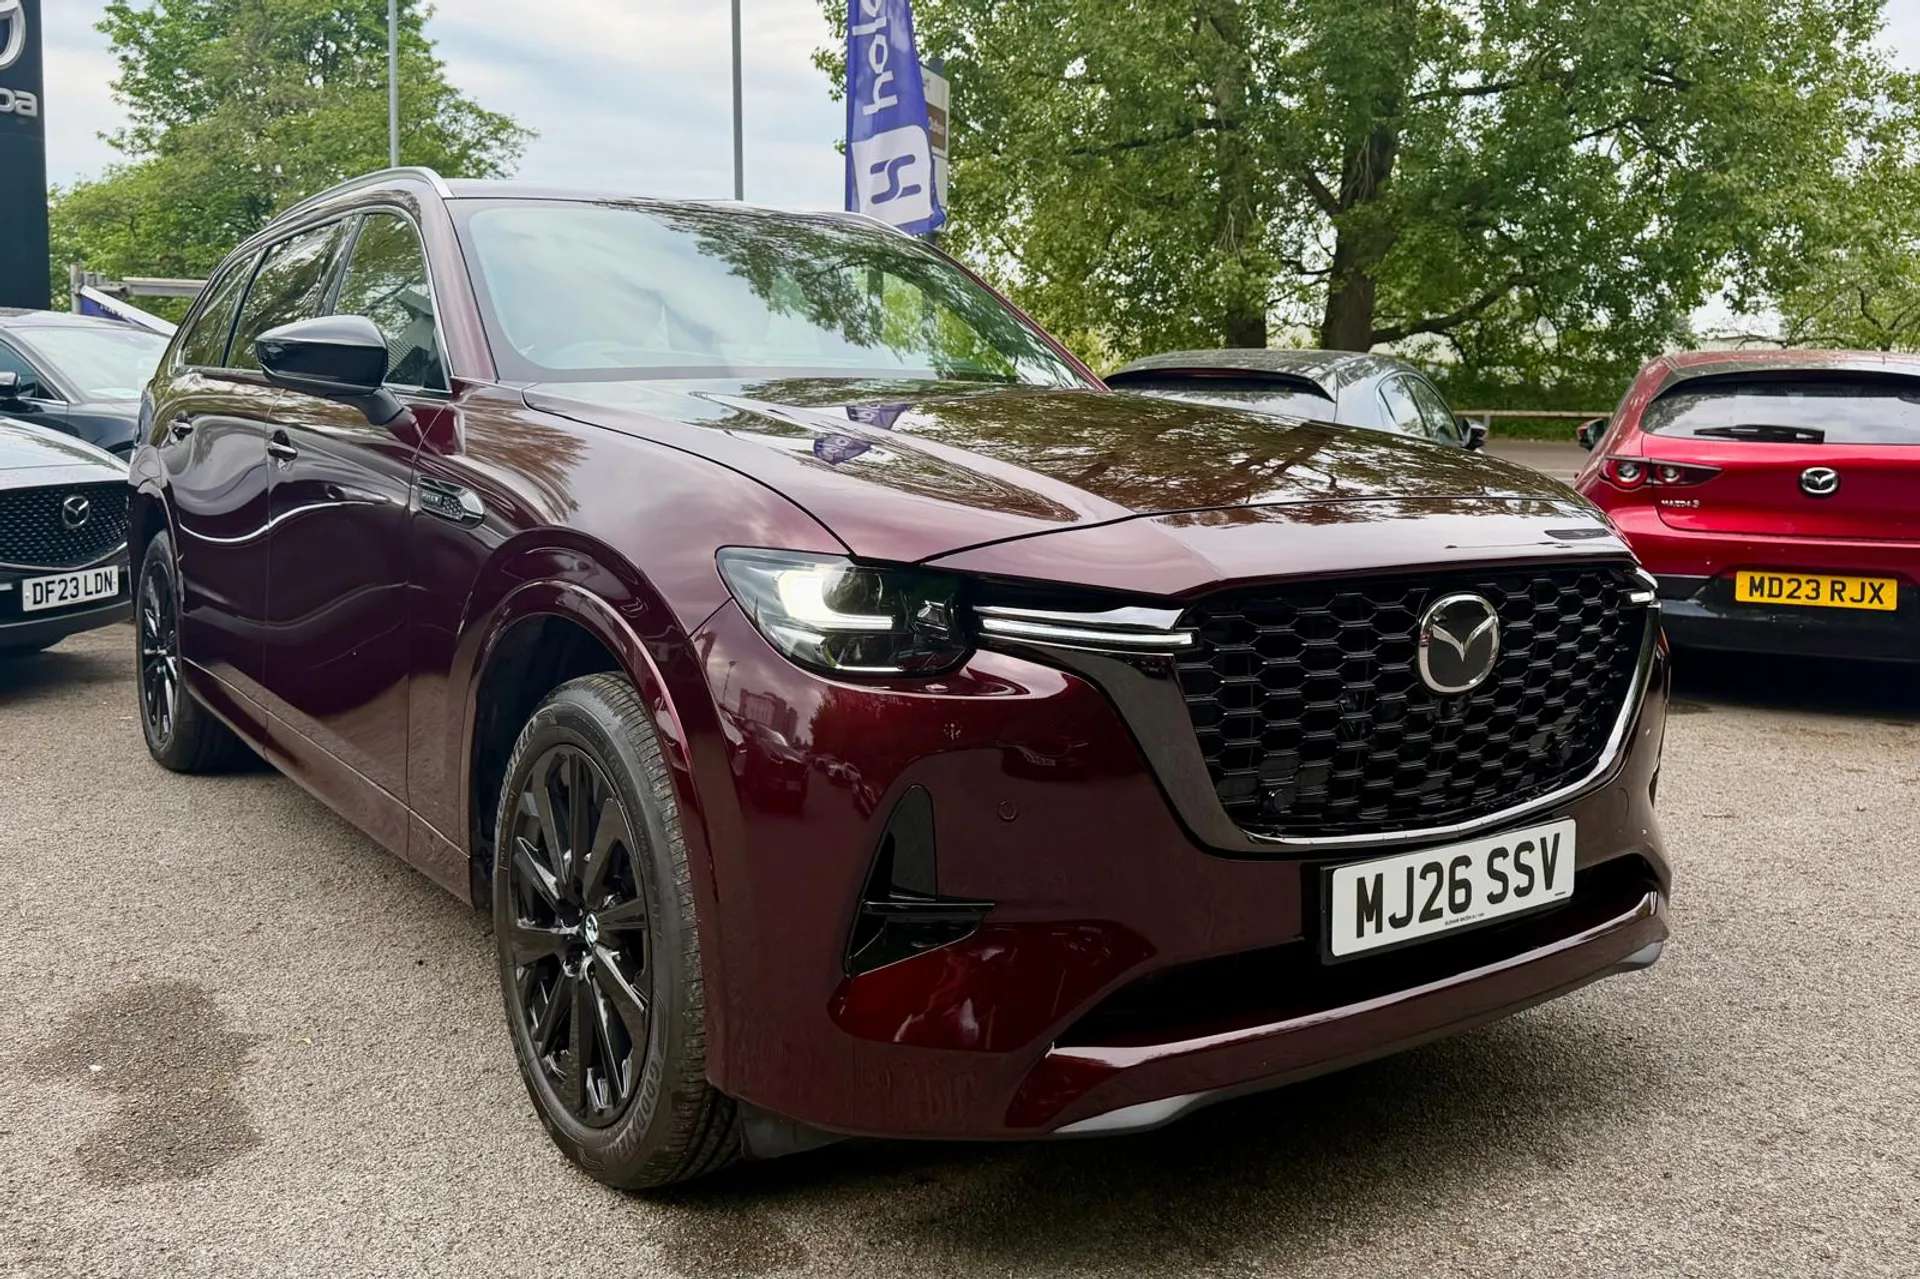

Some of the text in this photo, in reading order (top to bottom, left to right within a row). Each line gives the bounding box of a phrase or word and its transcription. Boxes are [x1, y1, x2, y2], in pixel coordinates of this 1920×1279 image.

[32, 570, 113, 605] DF23 LDN
[1749, 576, 1885, 604] MD23 RJX
[1356, 833, 1560, 939] MJ26 SSV
